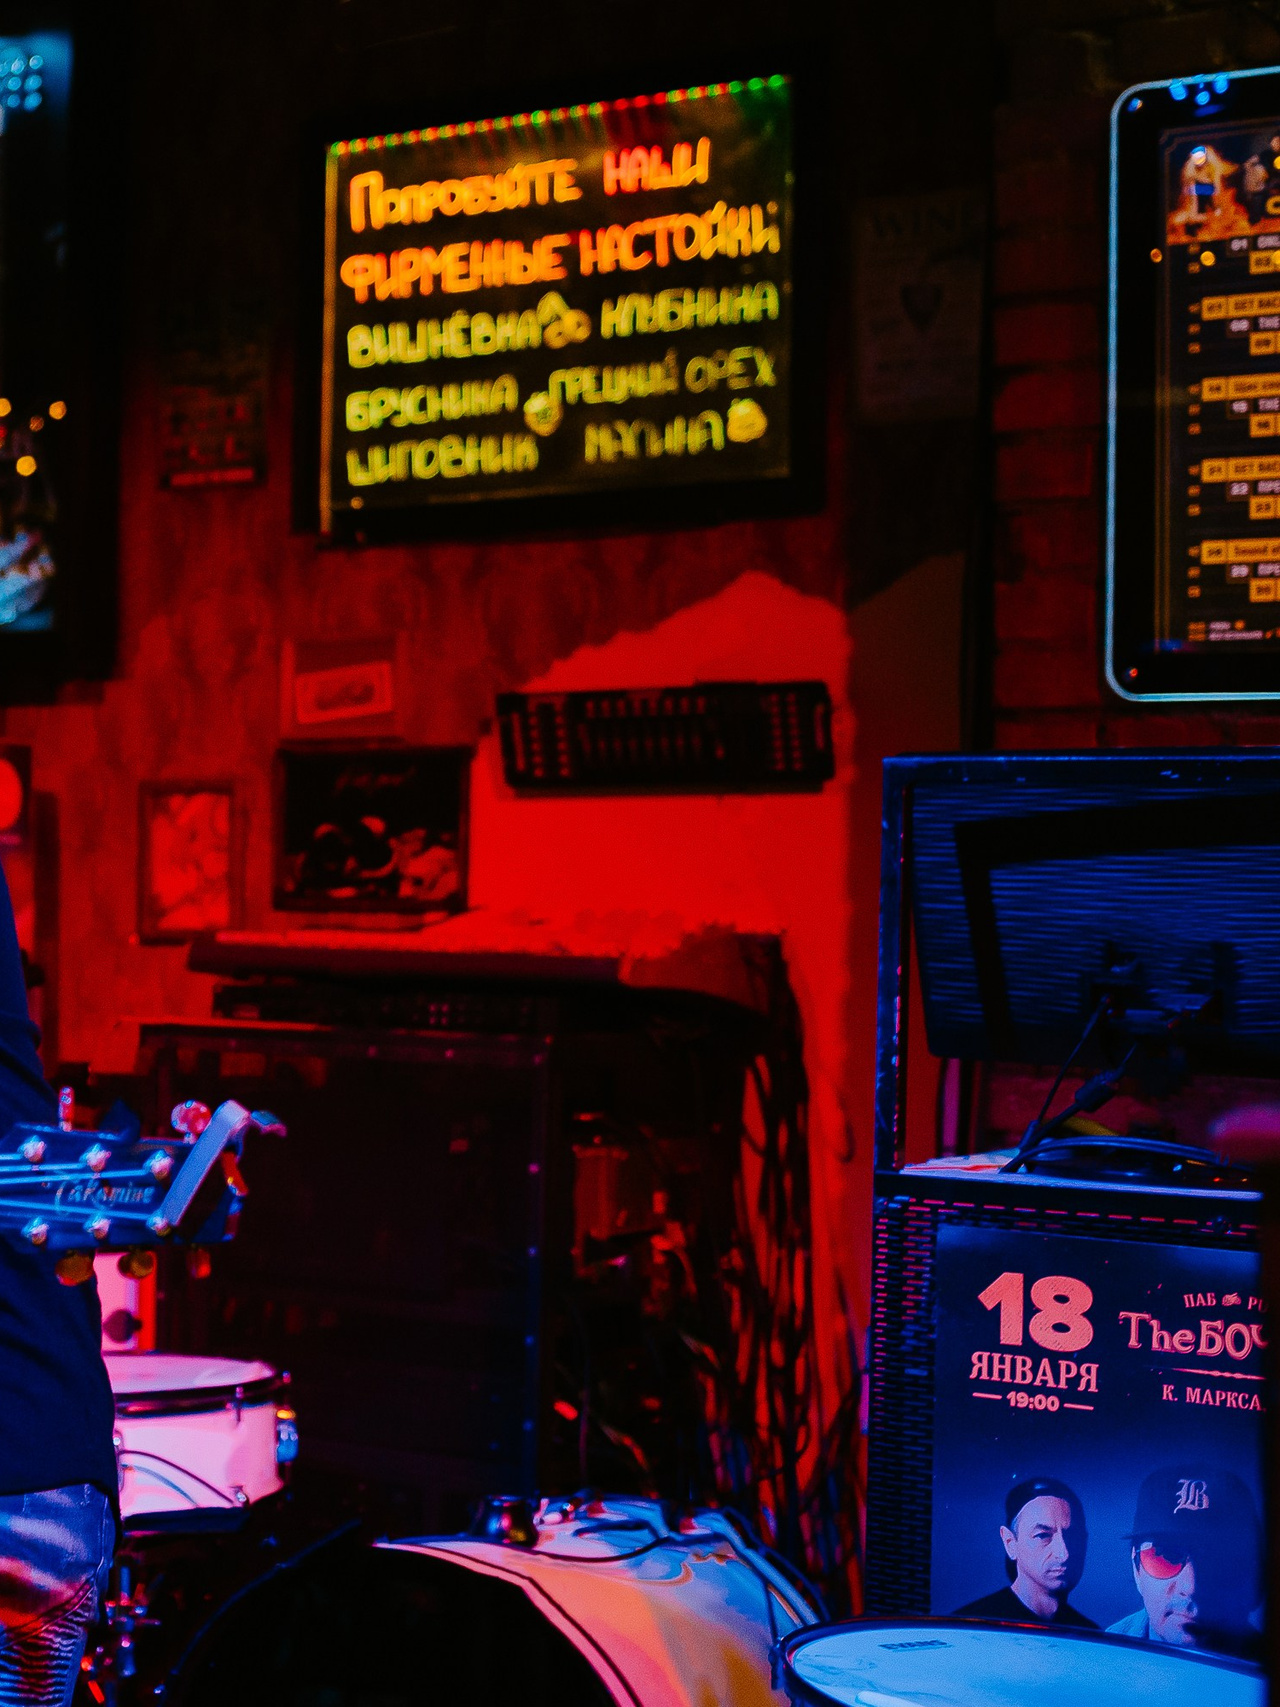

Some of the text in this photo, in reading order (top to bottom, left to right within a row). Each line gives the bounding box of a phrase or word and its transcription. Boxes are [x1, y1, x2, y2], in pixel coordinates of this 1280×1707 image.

[603, 136, 710, 196] НАШИ
[579, 201, 780, 277] НАСТОЙКИ
[601, 281, 780, 340] КЛУБНИКА
[346, 346, 777, 432] БРУСНИКА ГРЕЦКИЙ ОРЕХ
[346, 433, 539, 487] ШИПОВНИК
[977, 1271, 1094, 1352] 18
[1183, 1292, 1217, 1308] ПАБ
[969, 1351, 1099, 1393] ЯНВАРЯ
[1162, 1384, 1179, 1402] К.
[1006, 1390, 1060, 1412] 19:00
